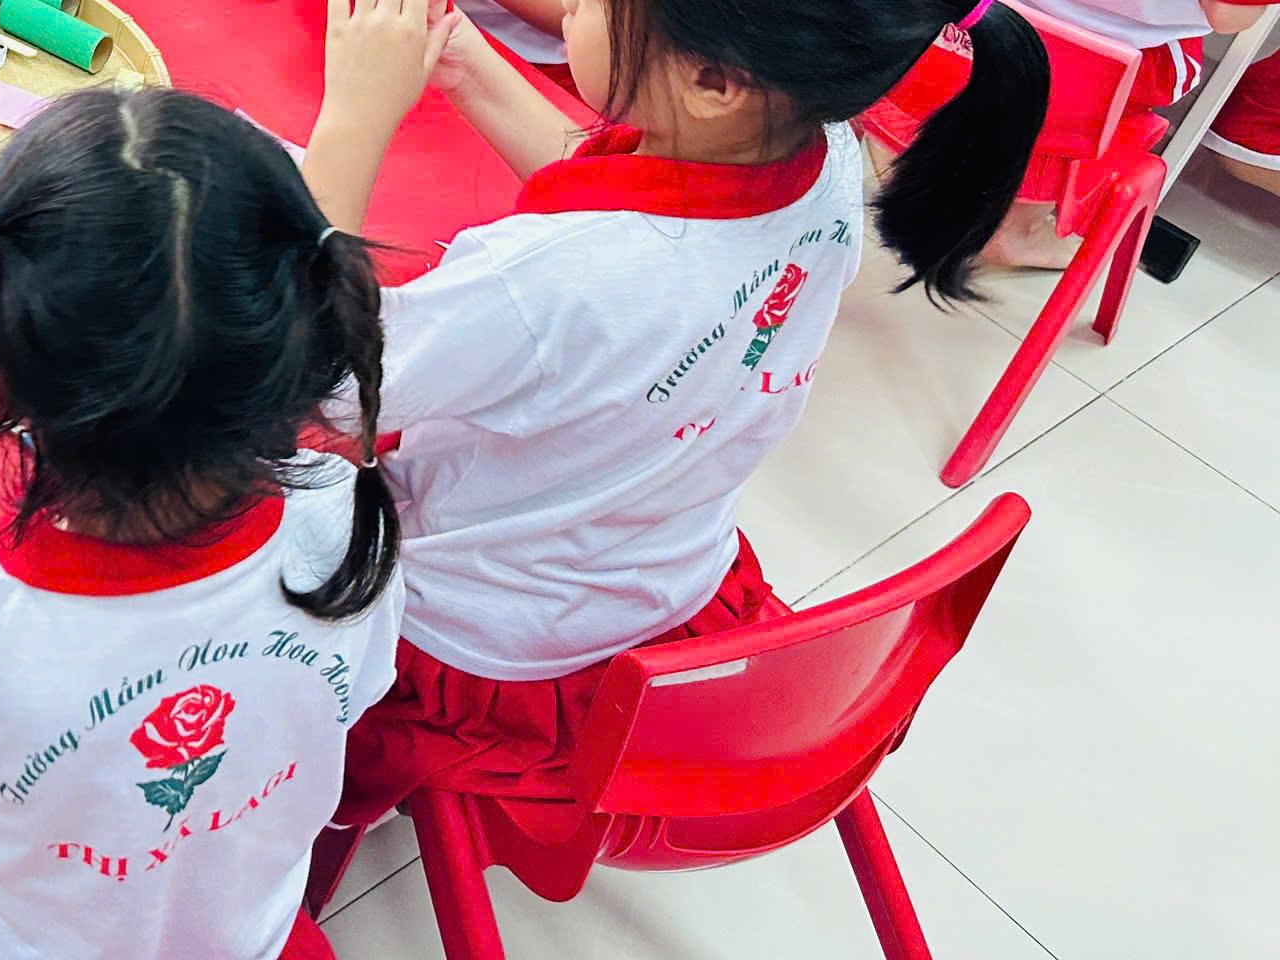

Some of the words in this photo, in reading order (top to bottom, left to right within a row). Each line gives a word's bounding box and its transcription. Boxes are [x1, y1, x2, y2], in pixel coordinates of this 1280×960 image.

[646, 320, 727, 405] Trường
[0, 727, 81, 807] Trường
[85, 668, 168, 732] Mầm
[178, 638, 250, 672] Non
[261, 630, 321, 667] Hoa
